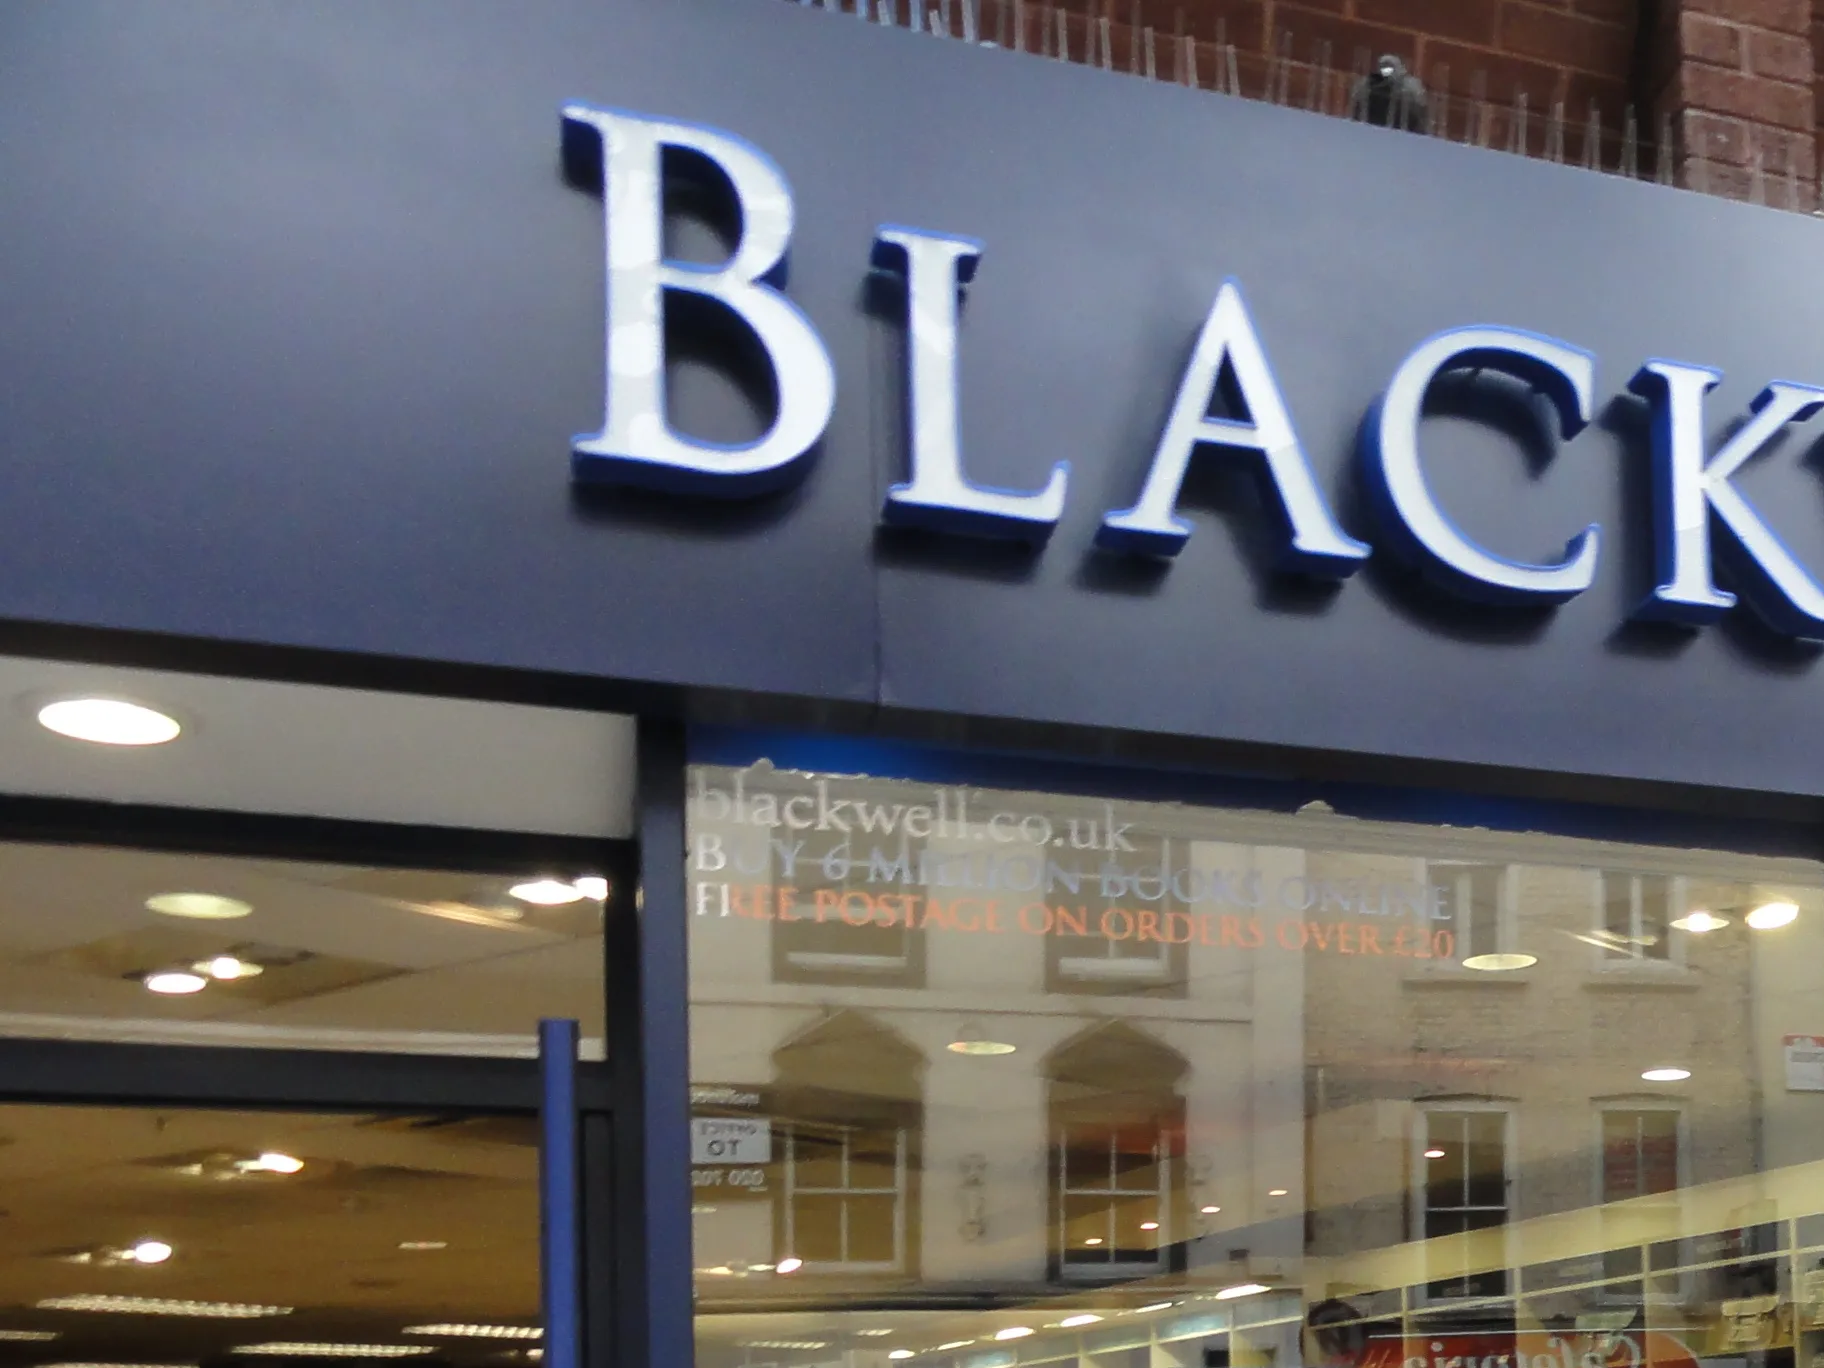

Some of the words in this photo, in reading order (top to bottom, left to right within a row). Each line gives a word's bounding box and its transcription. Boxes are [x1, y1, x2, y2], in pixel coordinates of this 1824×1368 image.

[695, 768, 1137, 852] blackwell.co.uk
[696, 832, 804, 878] BUY
[821, 842, 852, 881] 6
[868, 846, 1081, 895] MILLION
[1100, 862, 1265, 909] BOOKS
[1279, 875, 1452, 921] ONLINE
[696, 882, 801, 922] FREE
[813, 889, 1006, 934] POSTAGE
[1017, 902, 1088, 937] ON
[1101, 909, 1266, 950] ORDERS
[1277, 920, 1383, 956] OVER
[1393, 928, 1454, 959] £20
